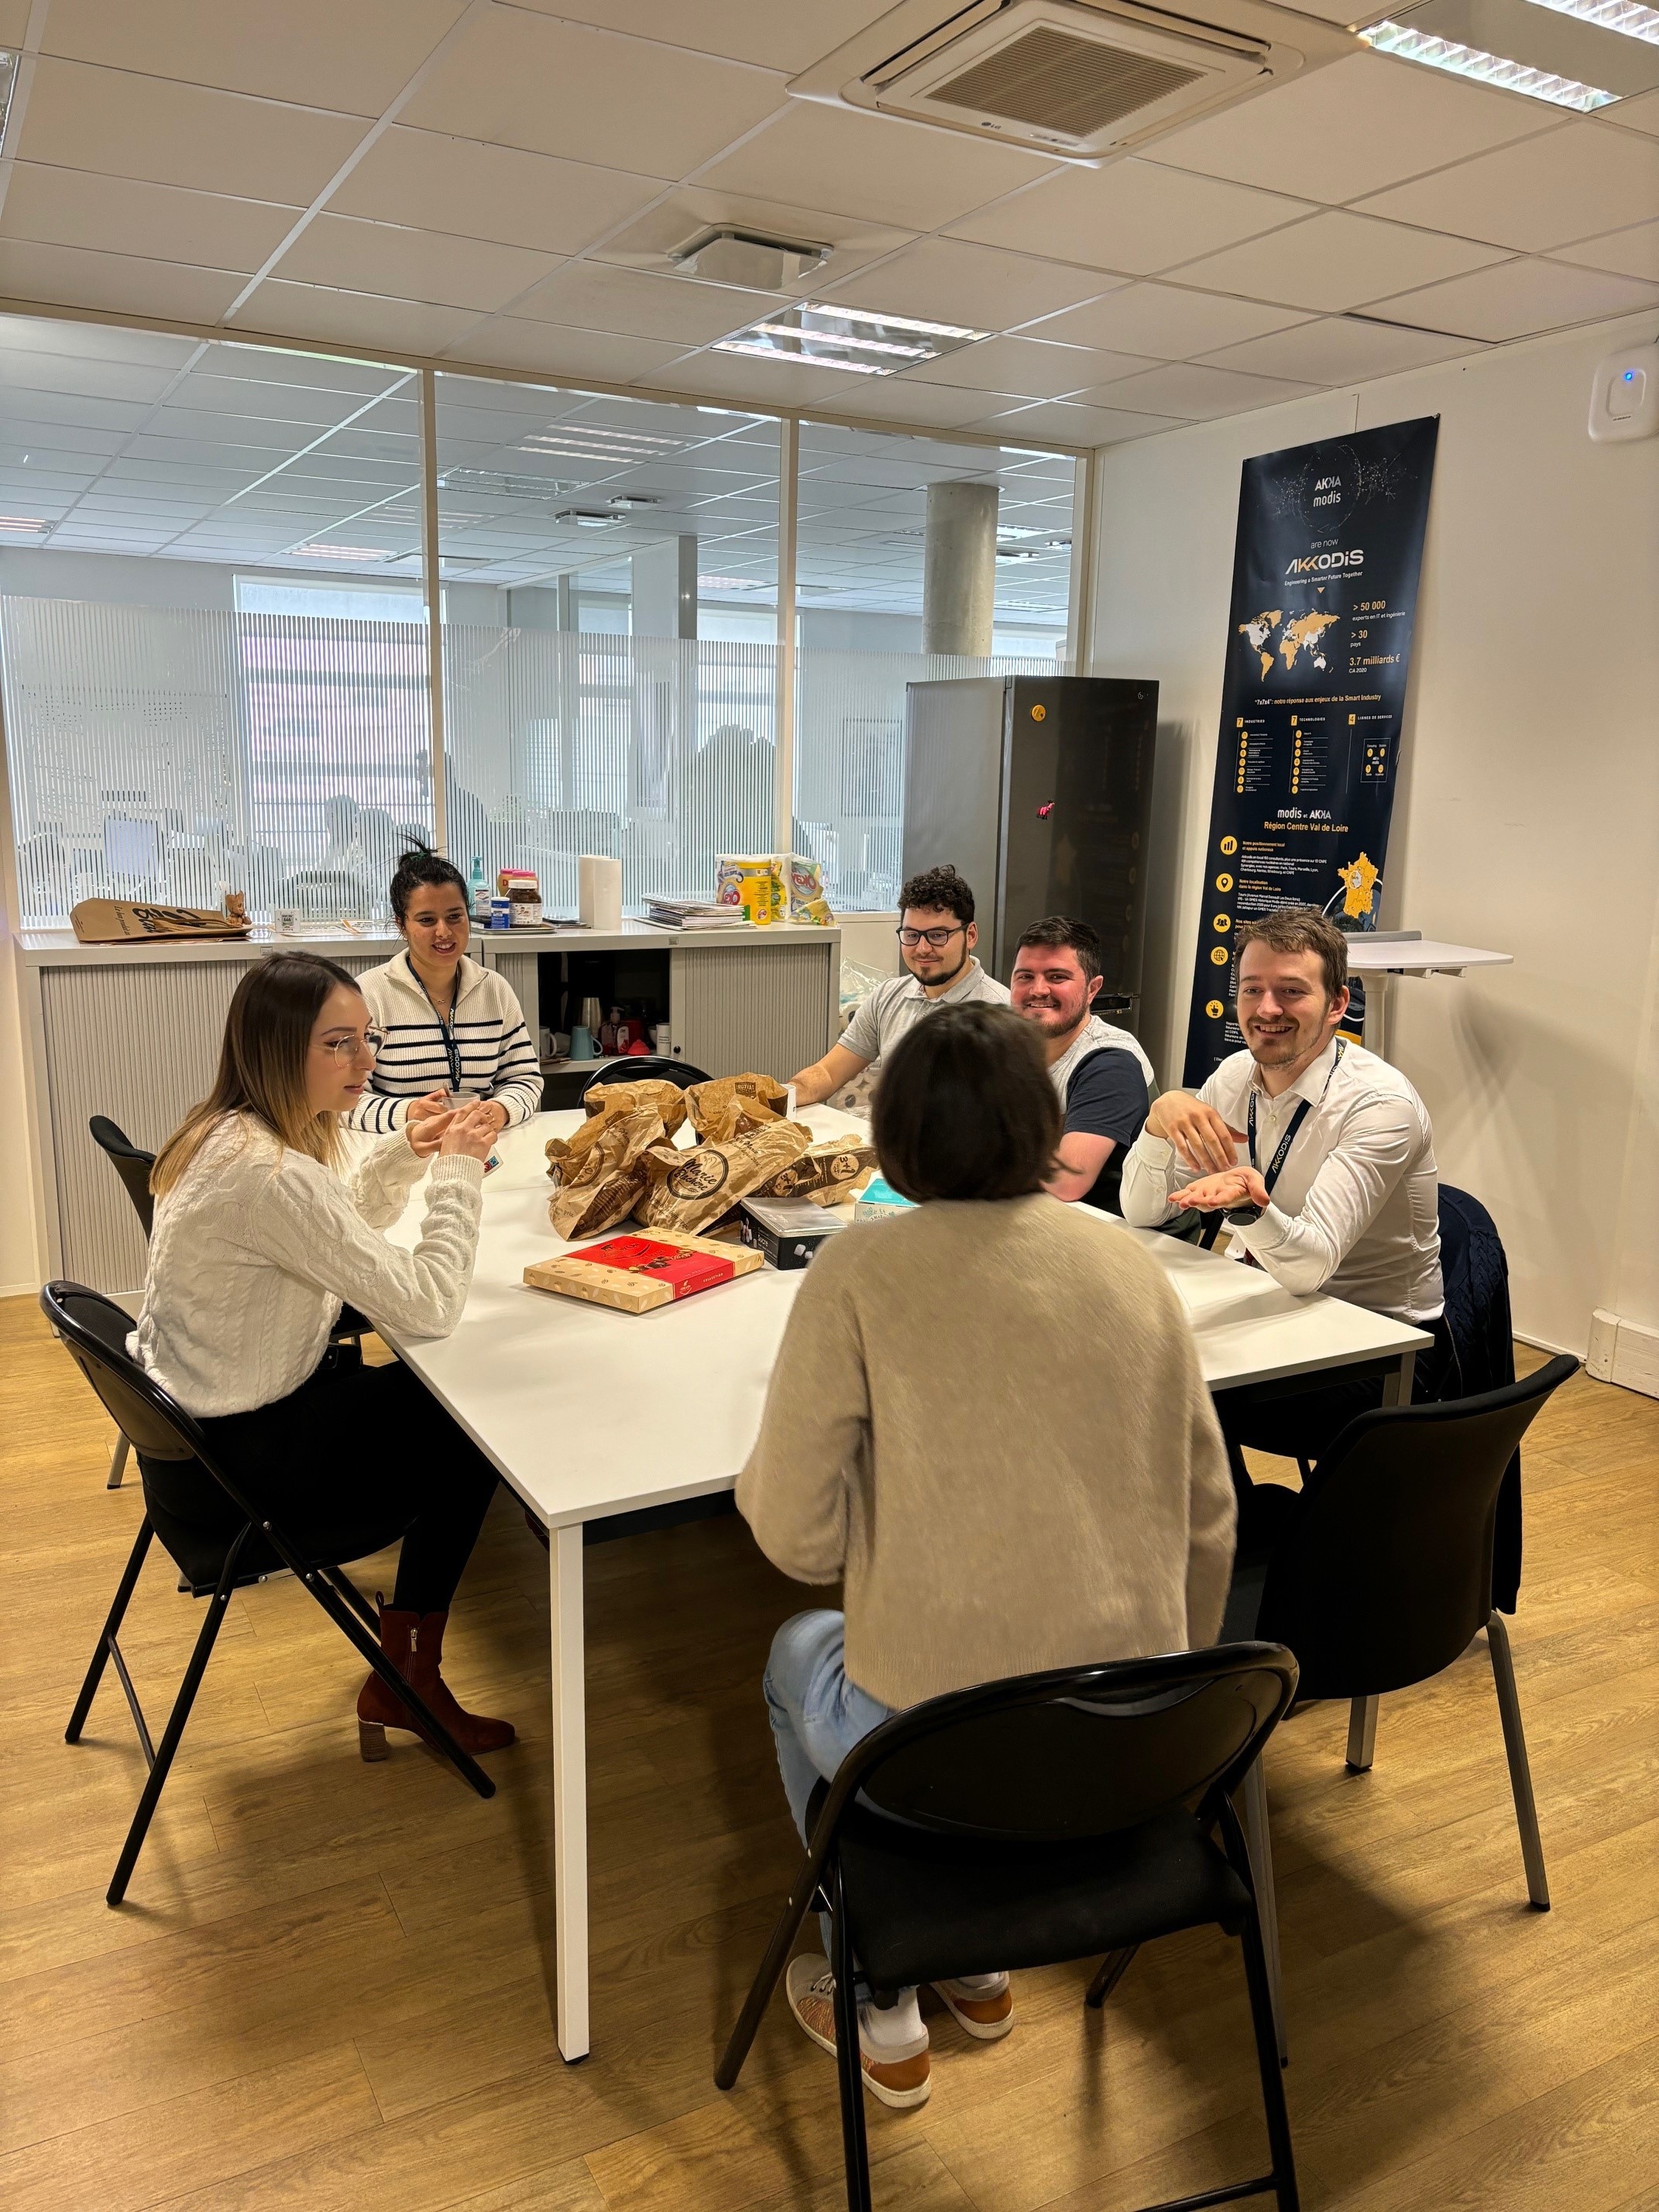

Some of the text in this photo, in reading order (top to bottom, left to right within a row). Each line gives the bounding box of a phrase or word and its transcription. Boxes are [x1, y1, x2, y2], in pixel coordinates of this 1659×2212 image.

[1314, 476, 1341, 491] AKKA
[1313, 490, 1341, 507] modis
[1323, 538, 1339, 548] now
[1284, 577, 1307, 586] Engineering
[1360, 602, 1370, 611] 50
[1372, 600, 1386, 610] 000
[1358, 630, 1368, 639] 30
[1349, 653, 1400, 666] 3.7 milliards €
[1361, 693, 1382, 702] Industry
[1277, 806, 1302, 819] modis
[1309, 809, 1332, 819] AKKA
[1263, 821, 1285, 831] Région
[1286, 823, 1308, 831] Centre
[1310, 823, 1321, 832] Val
[1331, 824, 1349, 833] Loire
[682, 1158, 718, 1186] Marie
[673, 1168, 709, 1192] Blachère
